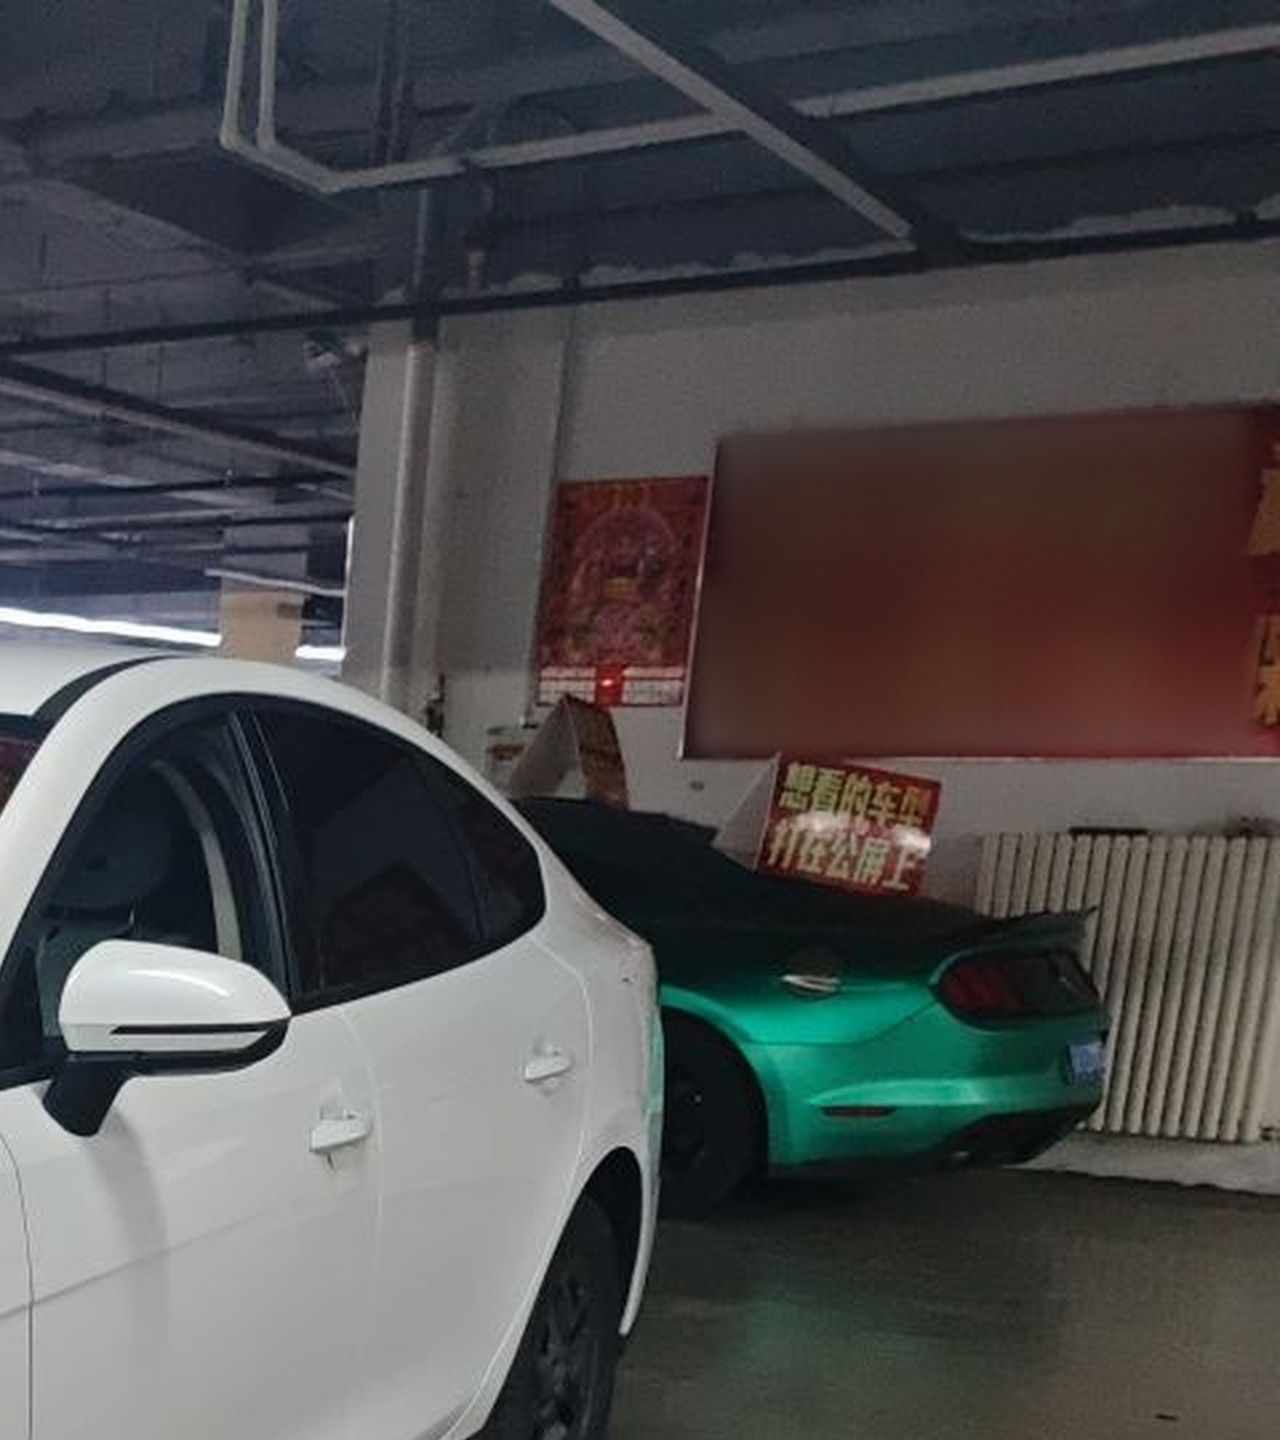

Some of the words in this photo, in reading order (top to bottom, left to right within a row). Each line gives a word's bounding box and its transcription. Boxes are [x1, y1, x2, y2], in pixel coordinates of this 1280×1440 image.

[778, 761, 933, 826] 想看的车型
